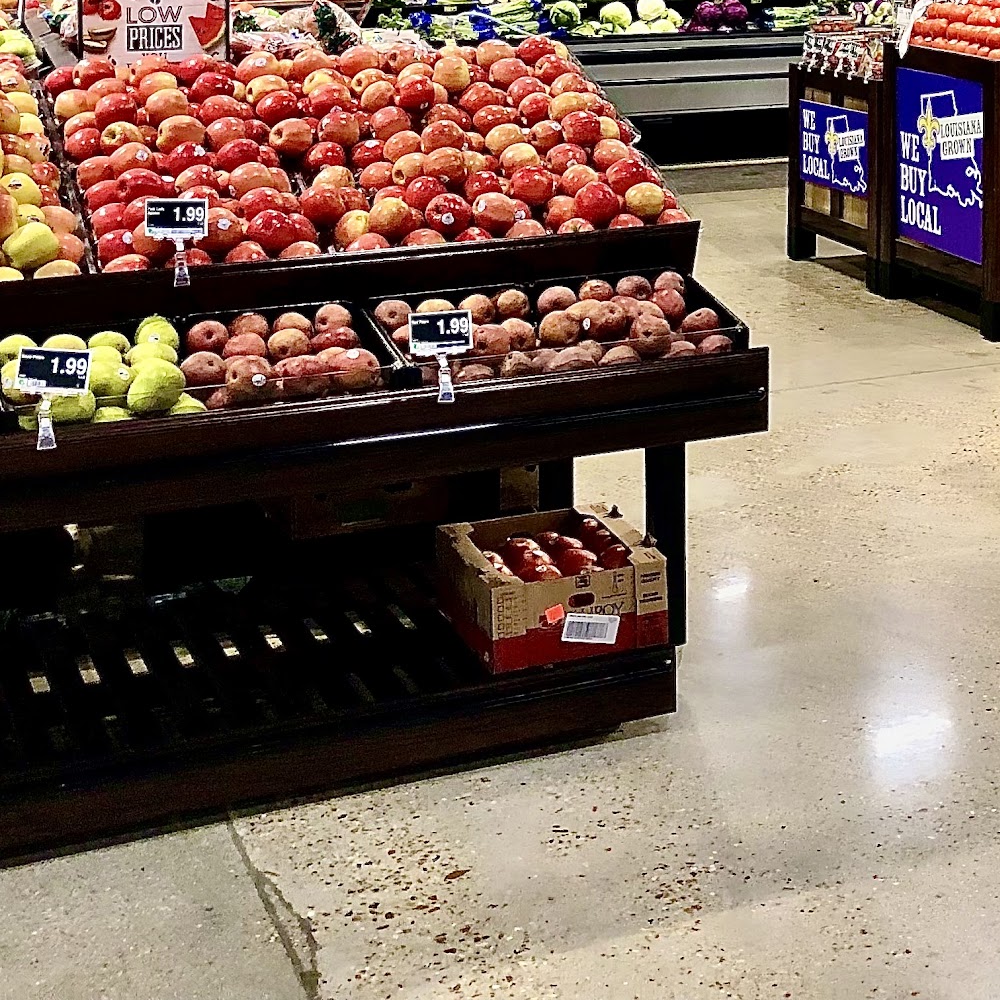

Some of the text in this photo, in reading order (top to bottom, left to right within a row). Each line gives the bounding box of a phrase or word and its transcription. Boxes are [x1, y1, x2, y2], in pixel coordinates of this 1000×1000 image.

[126, 5, 183, 25] LOW
[128, 26, 182, 51] PRICES
[802, 108, 816, 130] WE
[940, 118, 983, 139] LOUISIANA
[802, 130, 820, 154] BUY
[900, 130, 920, 163] WE
[942, 137, 973, 156] GROWN
[802, 153, 831, 181] LOCAL
[900, 162, 927, 197] BUY
[172, 206, 205, 222] 1.99
[900, 195, 942, 236] LOCAL
[438, 316, 469, 335] 1.99
[50, 356, 88, 375] 1.99
